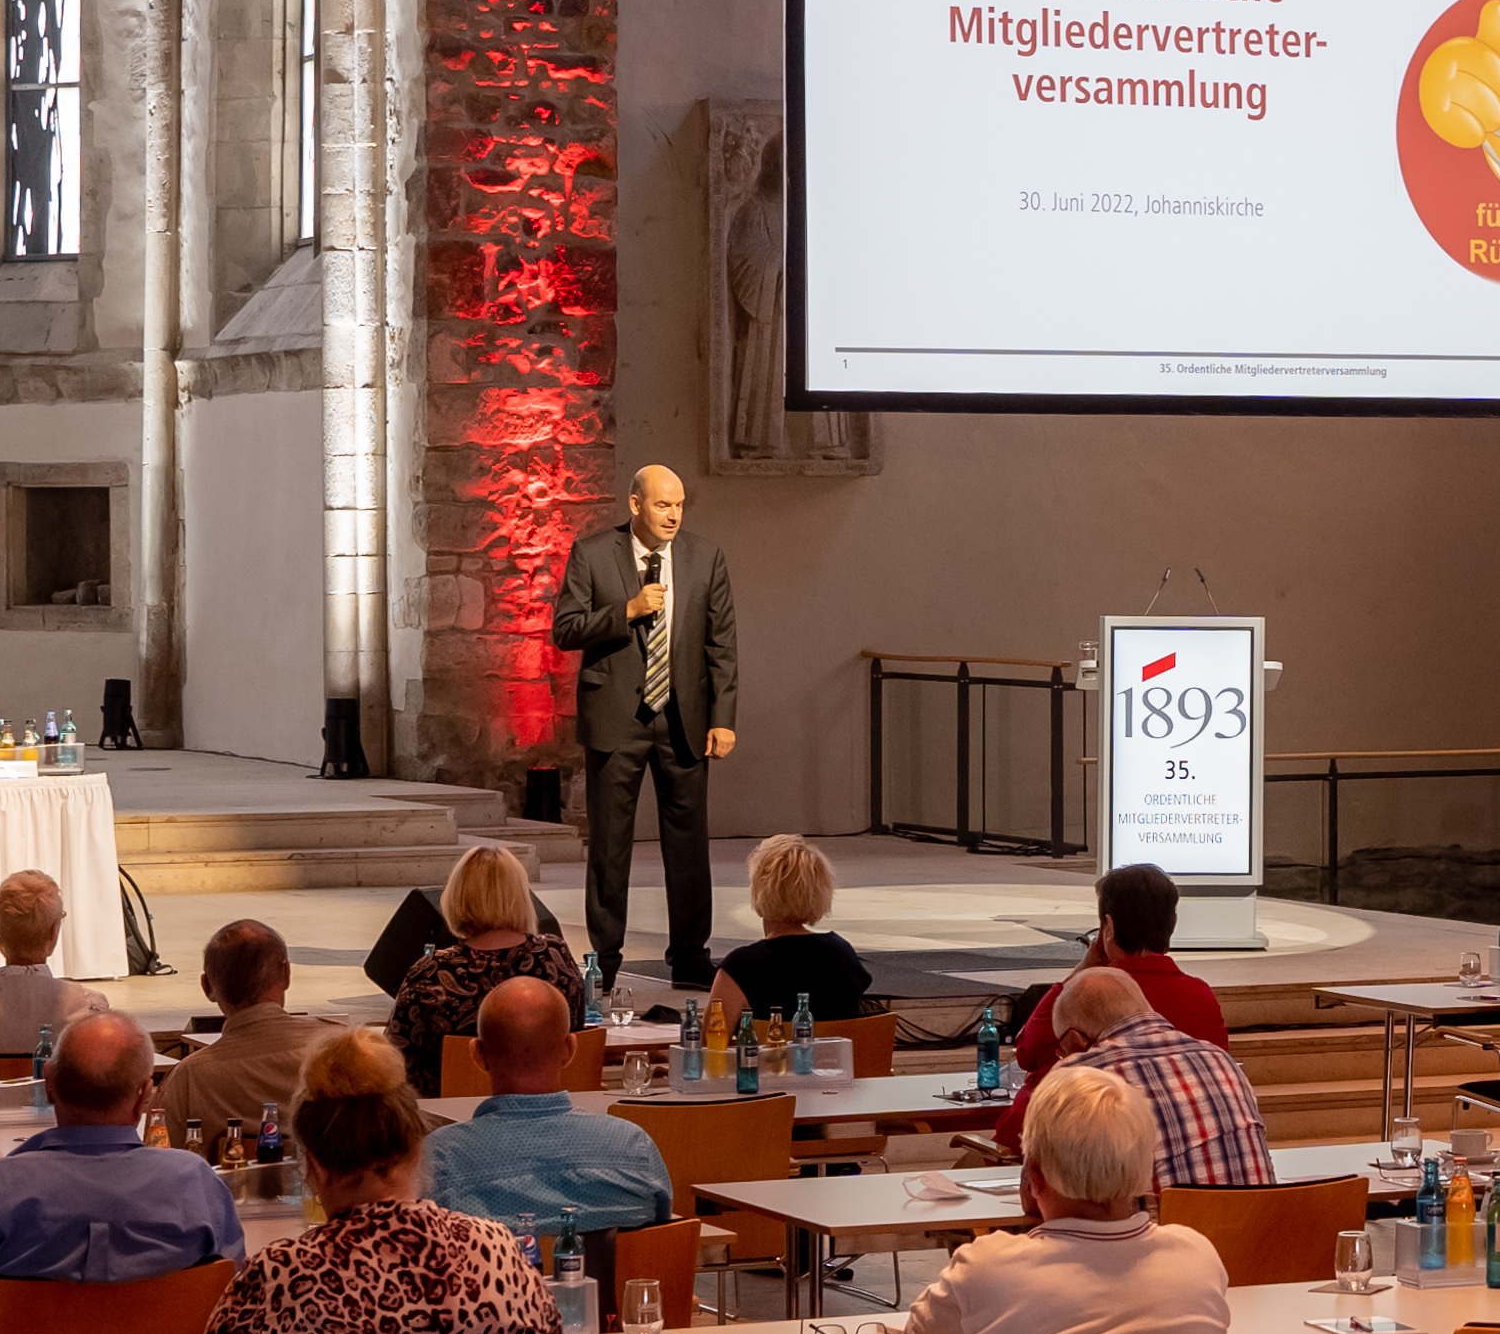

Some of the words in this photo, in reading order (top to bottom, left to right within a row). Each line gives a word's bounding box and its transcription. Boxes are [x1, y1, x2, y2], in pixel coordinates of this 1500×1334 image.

[949, 5, 1328, 59] Mitgliedervertreter-
[1012, 69, 1267, 120] versammlung
[1019, 191, 1046, 211] 30.
[1051, 192, 1084, 212] Juni
[1090, 193, 1139, 217] 2022,
[1144, 195, 1264, 217] Johanniskirche
[842, 358, 848, 370] 1
[1159, 363, 1174, 374] 35.
[1176, 363, 1232, 374] Ordentliche
[1235, 364, 1387, 378] Mitgliedervertreterversammlung
[1116, 687, 1247, 749] 1893
[1164, 759, 1196, 781] 35.
[1143, 793, 1217, 806] ORDENTLICHE
[1118, 812, 1243, 825] MITGLIEDERVERTRETER-
[1138, 831, 1223, 845] VERSAMMLUNG
